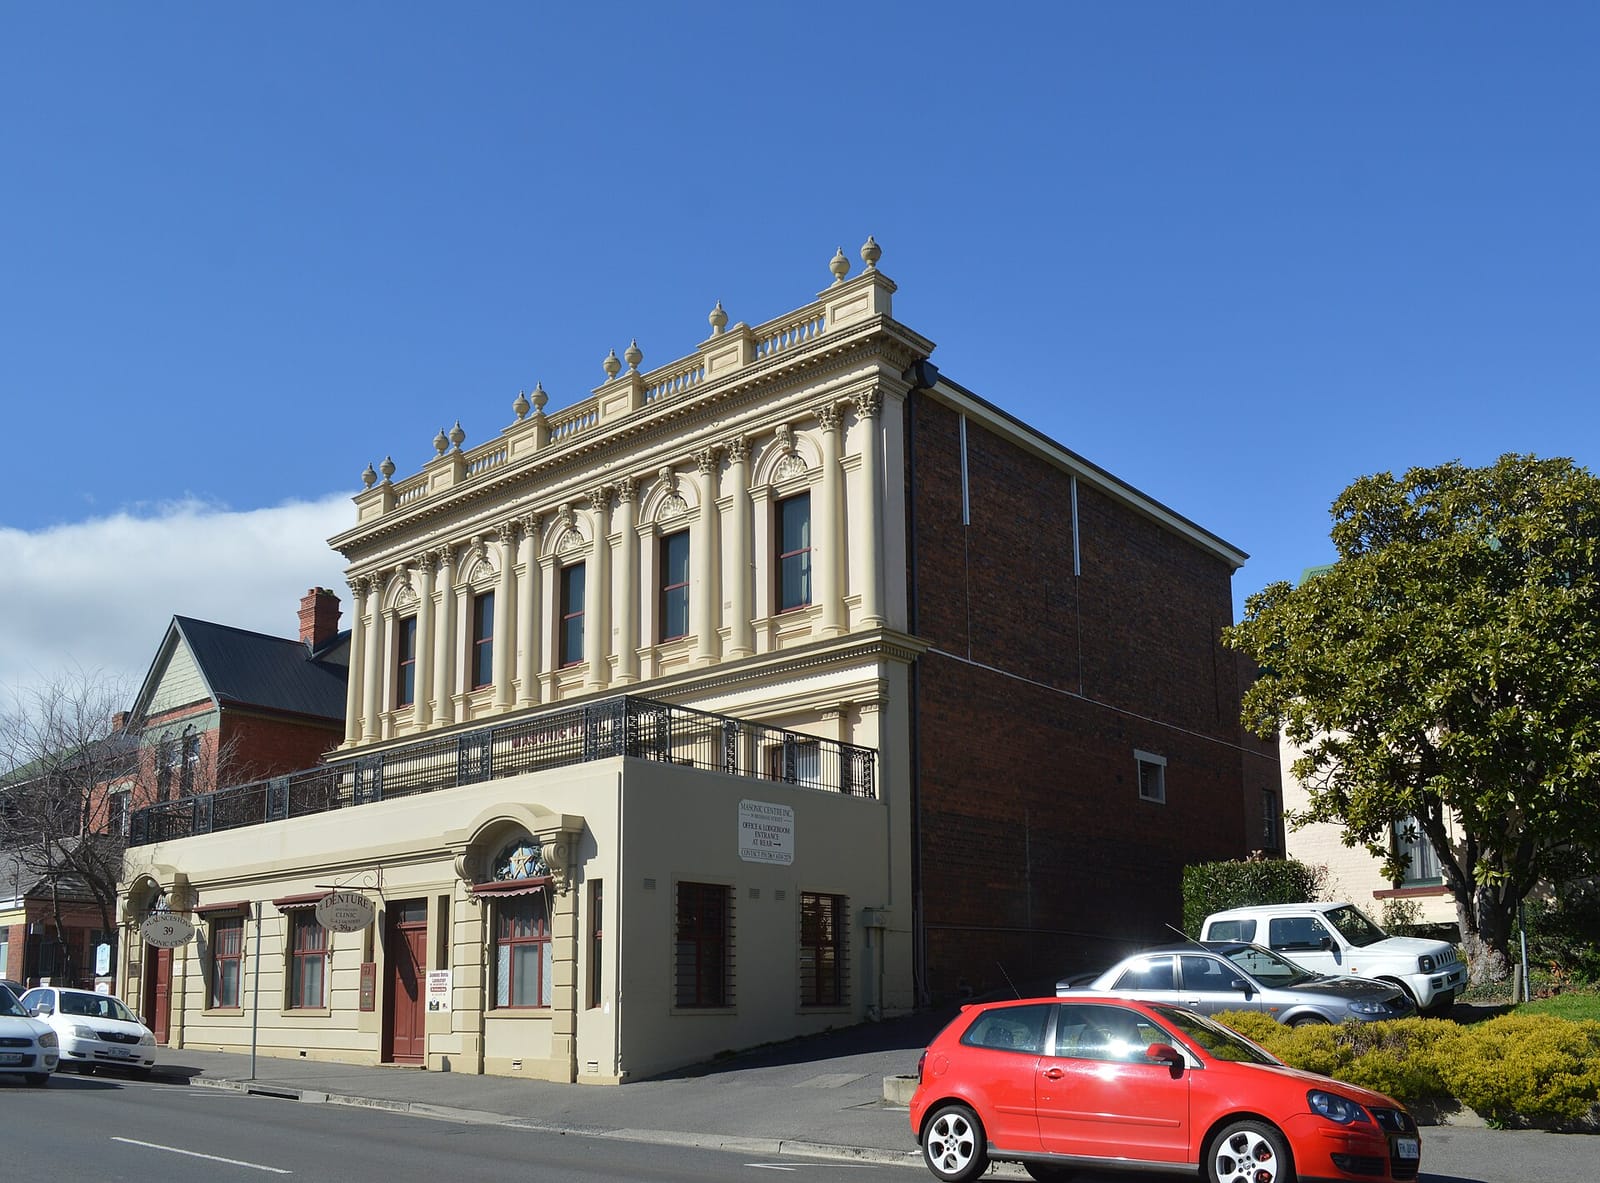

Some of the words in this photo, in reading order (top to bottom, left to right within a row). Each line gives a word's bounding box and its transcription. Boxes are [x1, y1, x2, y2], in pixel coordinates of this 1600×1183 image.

[742, 822, 758, 830] OFFICE
[754, 831, 779, 840] ENTRANCE
[325, 894, 369, 909] DENTURE
[148, 915, 188, 927] LAUNCESTON
[163, 926, 174, 936] 39
[144, 930, 168, 947] MASONIC
